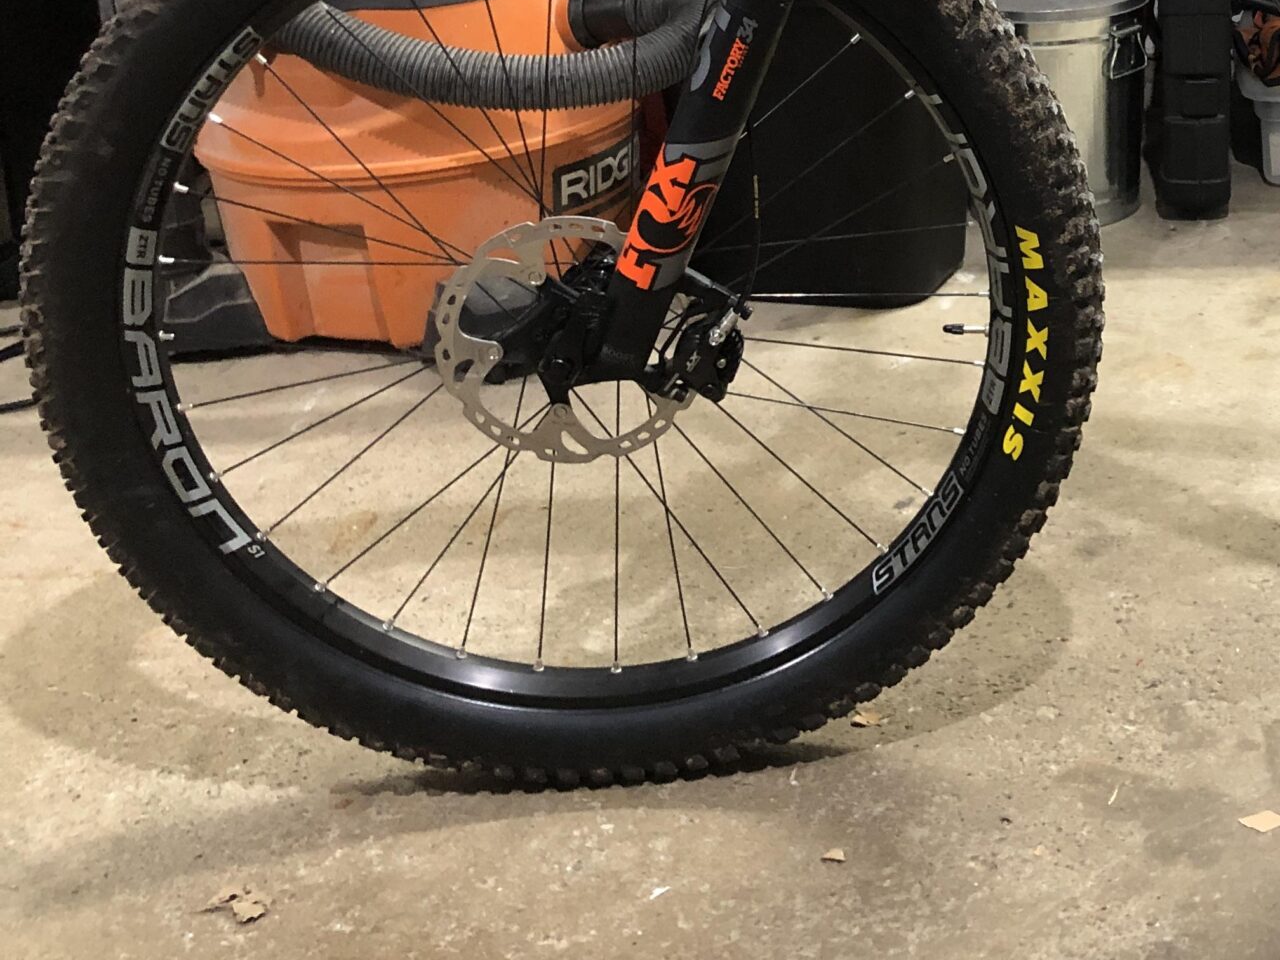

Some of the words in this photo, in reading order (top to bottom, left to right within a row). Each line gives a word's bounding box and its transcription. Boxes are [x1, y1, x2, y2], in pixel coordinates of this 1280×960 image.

[712, 37, 748, 102] FACTORY
[615, 143, 716, 290] FOX
[1002, 225, 1049, 462] MAXXIS
[872, 470, 965, 595] STANS
